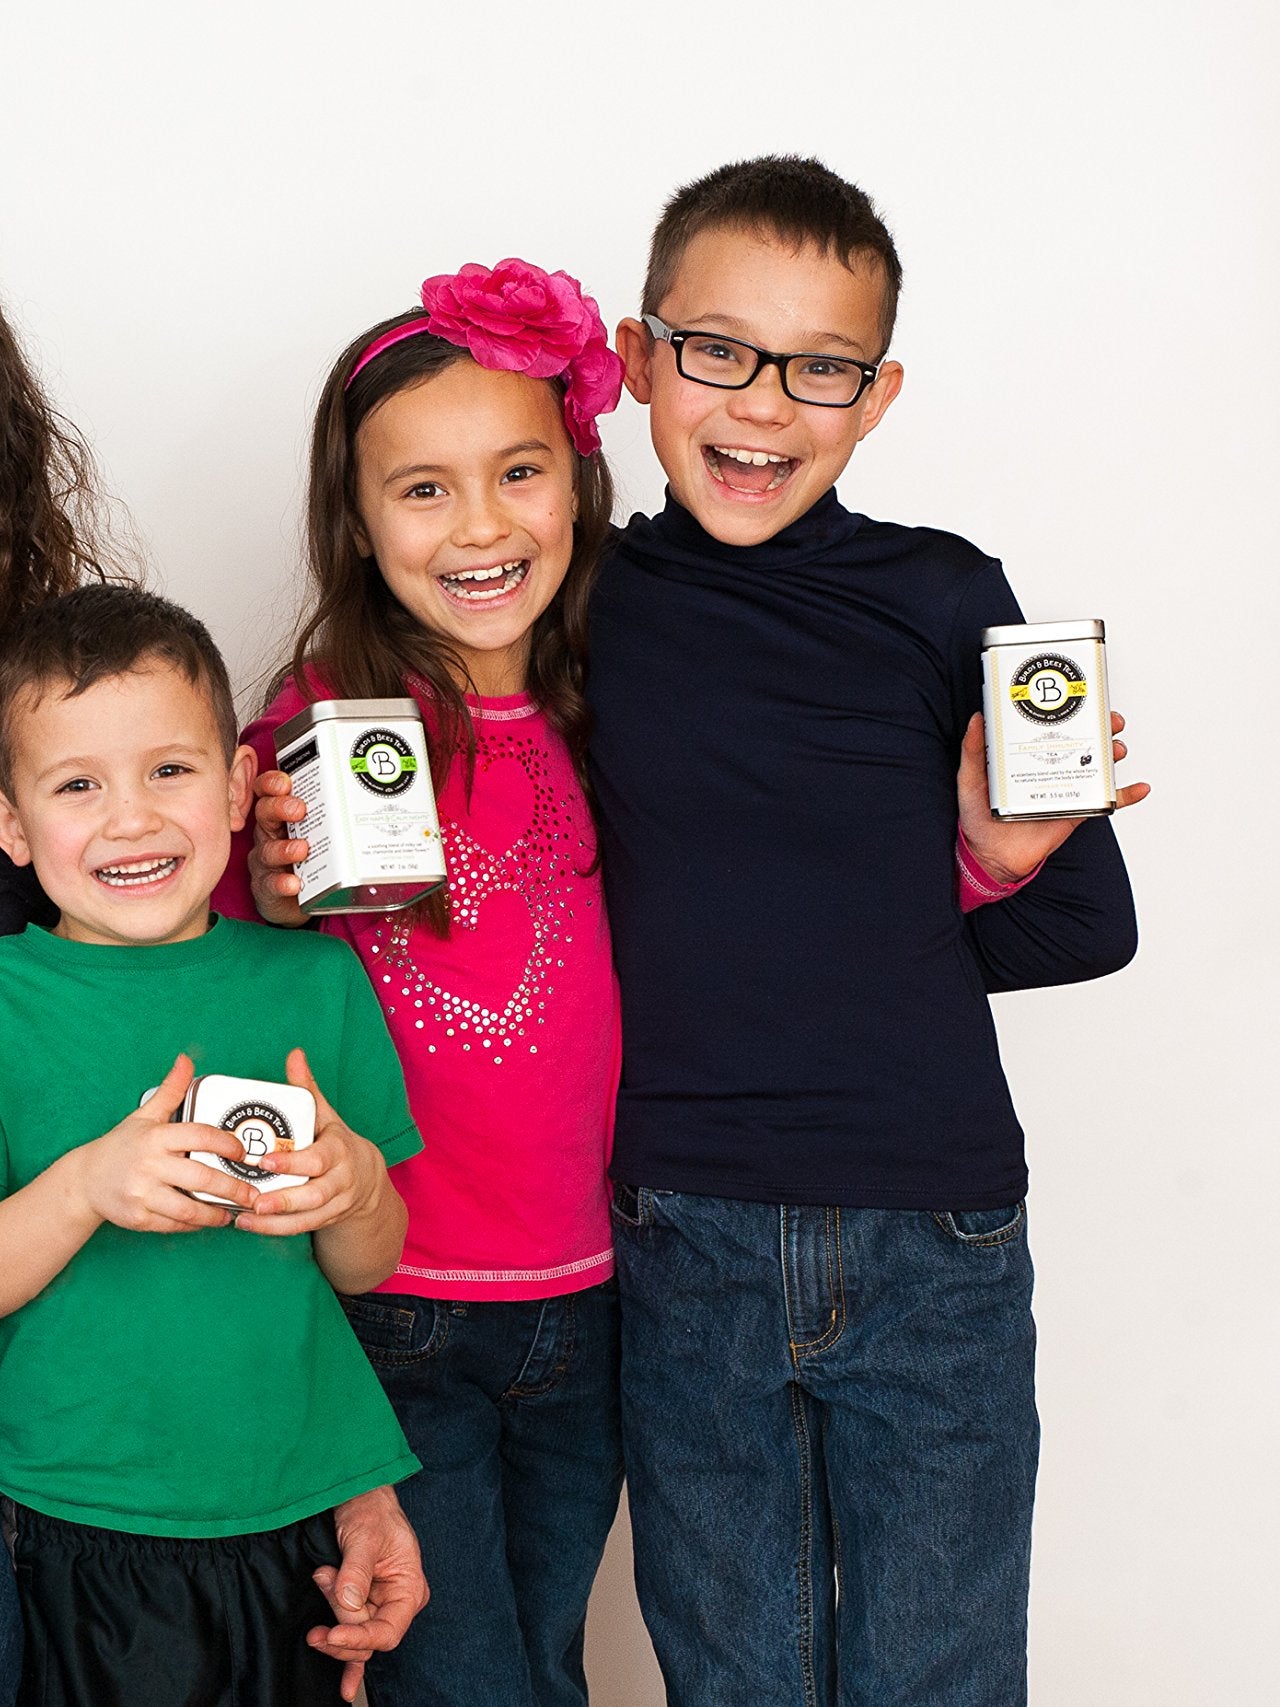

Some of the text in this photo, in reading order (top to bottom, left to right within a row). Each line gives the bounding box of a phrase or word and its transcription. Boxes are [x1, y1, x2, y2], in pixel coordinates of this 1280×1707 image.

[1036, 677, 1061, 702] B
[372, 751, 395, 775] B
[247, 1107, 252, 1116] &
[254, 1107, 273, 1120] BEES
[243, 1128, 267, 1156] B
